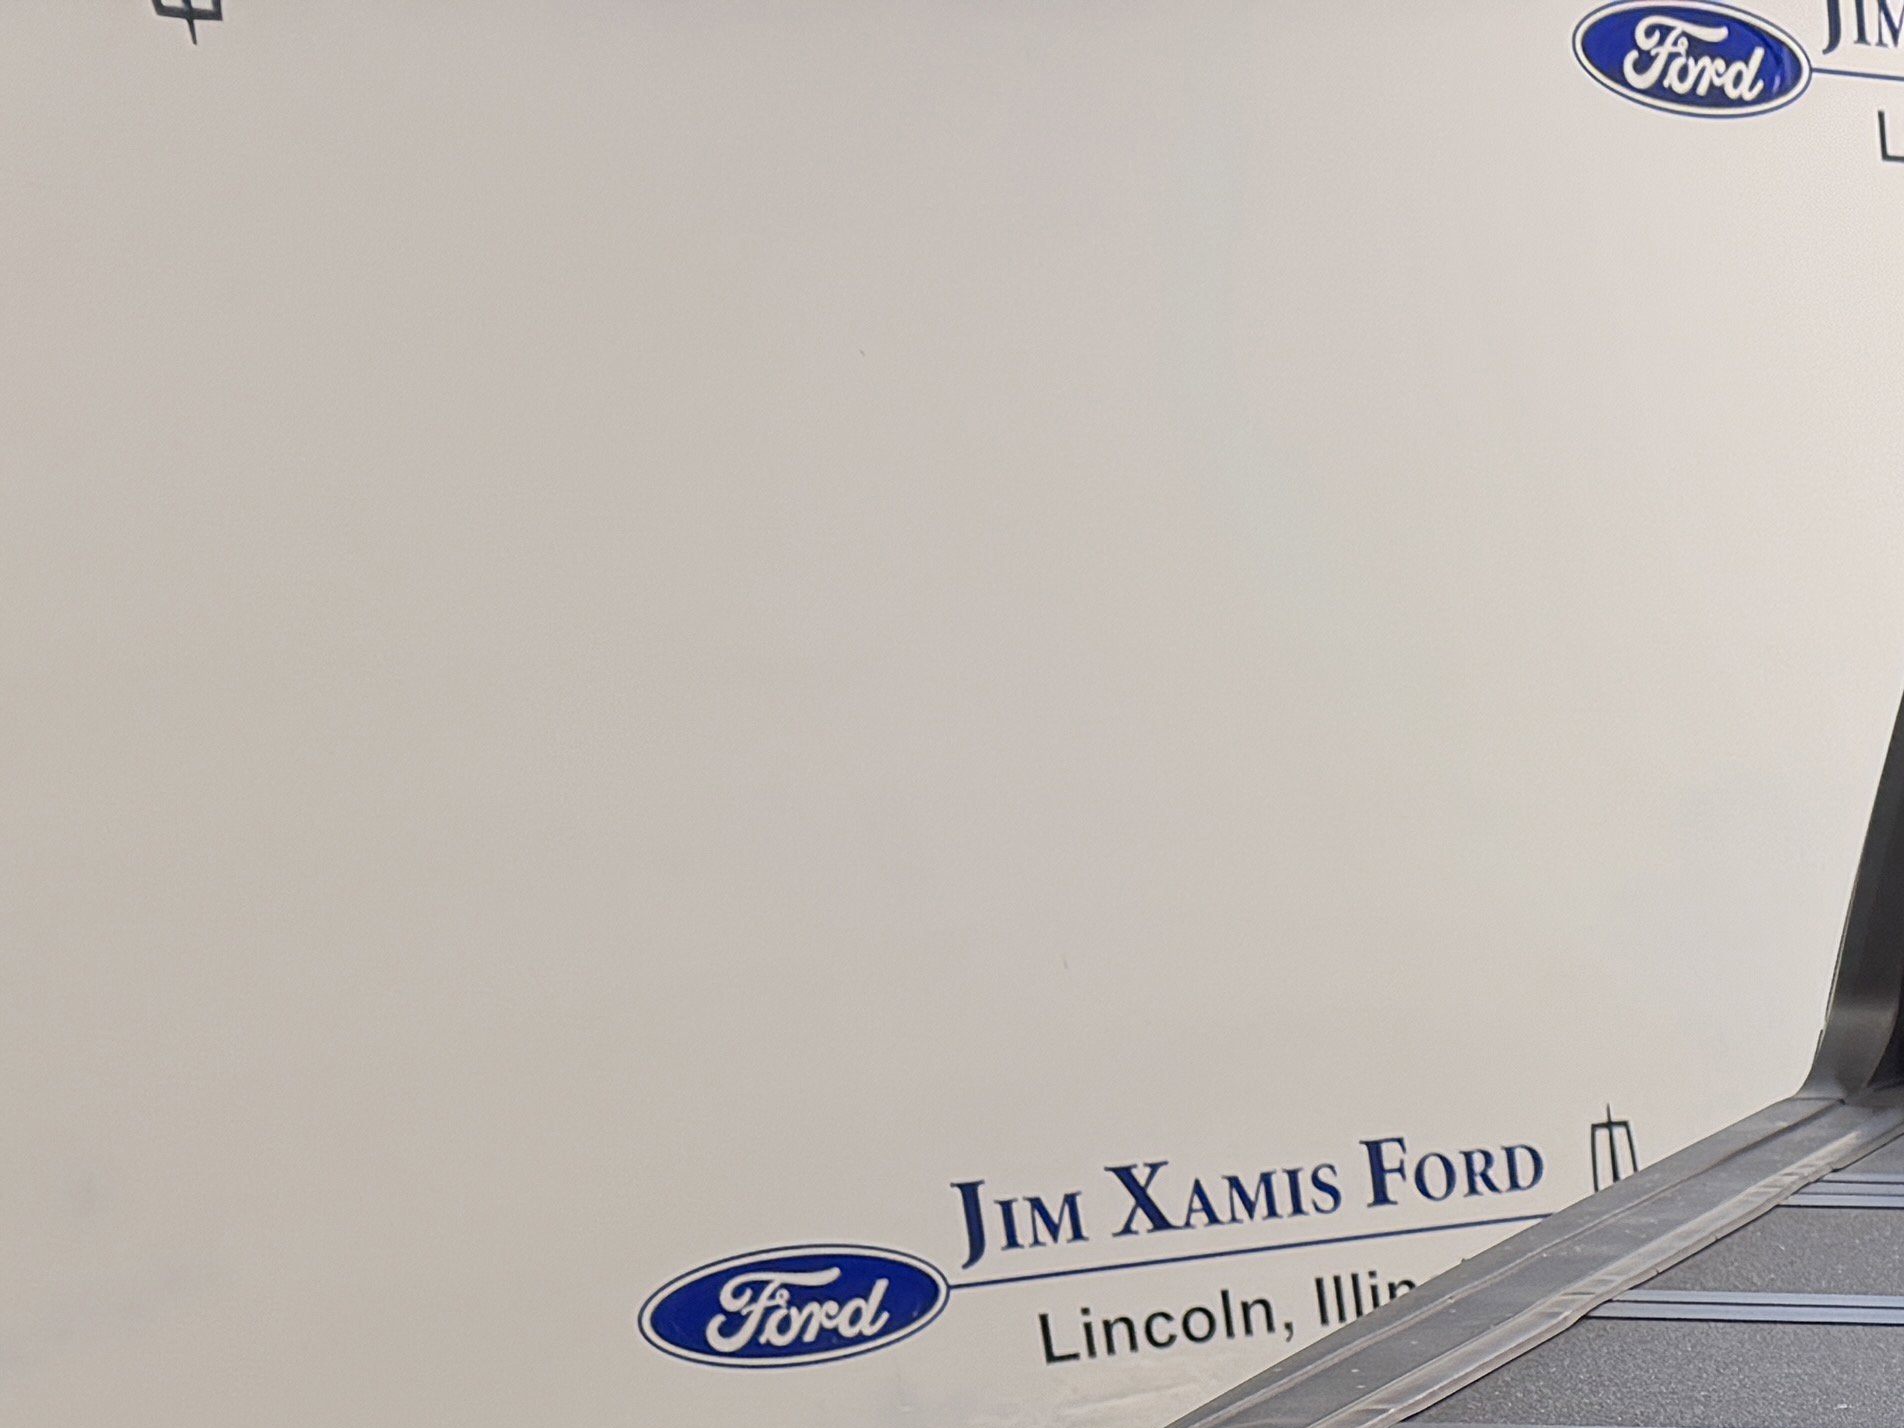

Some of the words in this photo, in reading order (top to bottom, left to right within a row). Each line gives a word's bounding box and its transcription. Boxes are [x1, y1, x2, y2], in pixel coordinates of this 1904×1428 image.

[1622, 14, 1766, 102] Ford
[949, 1178, 1090, 1270] JIM
[1103, 1159, 1342, 1238] XAMIS
[1358, 1135, 1545, 1208] FORD
[705, 1265, 890, 1353] Ford
[1037, 1288, 1296, 1366] Lincoln,
